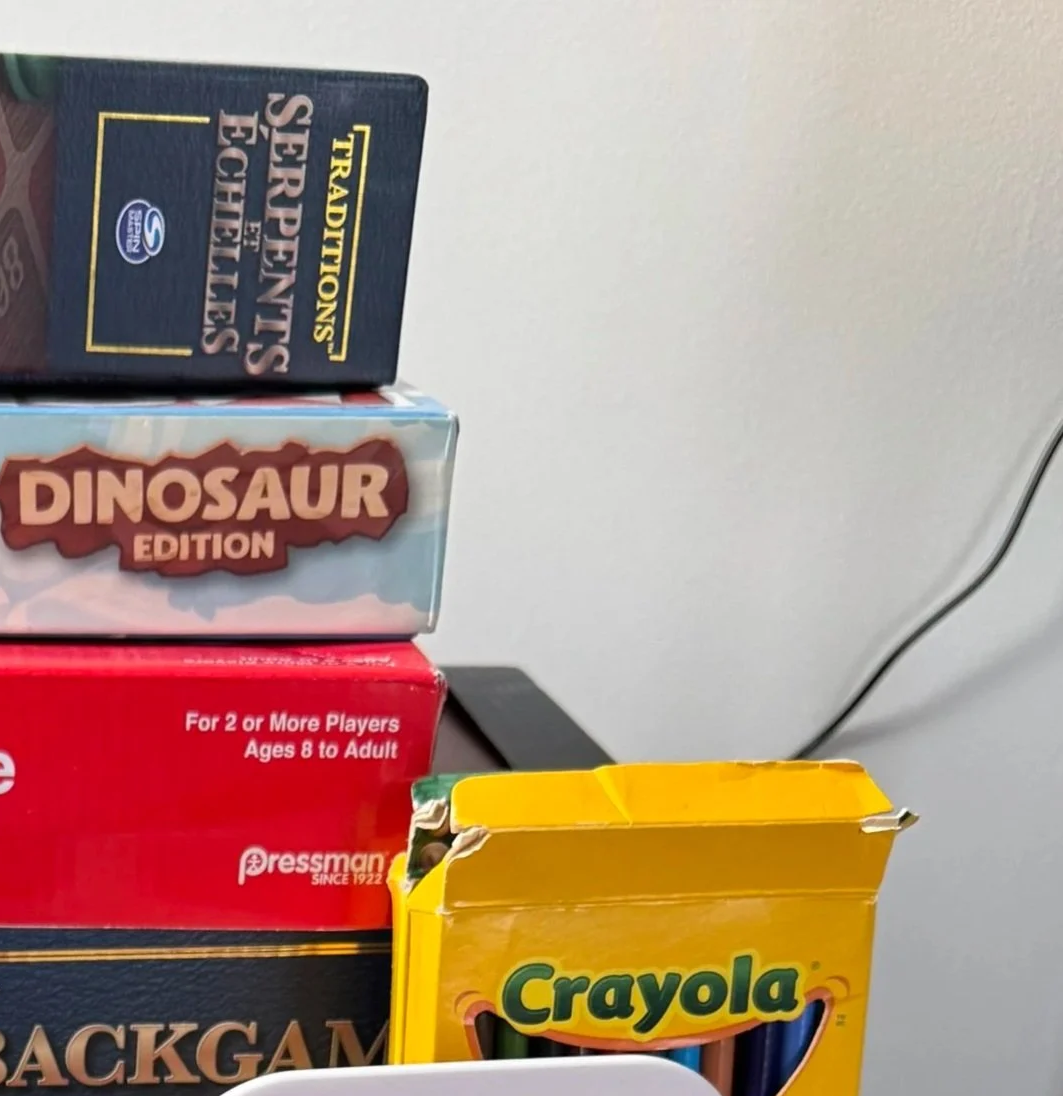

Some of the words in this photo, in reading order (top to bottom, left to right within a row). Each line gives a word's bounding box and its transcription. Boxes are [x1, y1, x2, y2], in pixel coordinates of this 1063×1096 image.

[132, 209, 143, 254] SPIN
[201, 109, 269, 355] ÉCHELLES
[243, 220, 262, 253] ET
[245, 92, 314, 375] SERPENTS
[18, 463, 389, 527] DINOSAUR
[132, 530, 276, 563] EDITION
[185, 712, 219, 732] For
[224, 713, 237, 732] 2
[242, 716, 263, 732] or
[269, 713, 320, 733] More
[325, 713, 400, 737] Players
[244, 739, 295, 762] Ages
[300, 740, 313, 759] 8
[318, 741, 339, 759] to
[344, 739, 398, 760] Adult
[311, 873, 349, 886] SINCE
[352, 872, 383, 885] 1922
[500, 953, 800, 1035] Crayola
